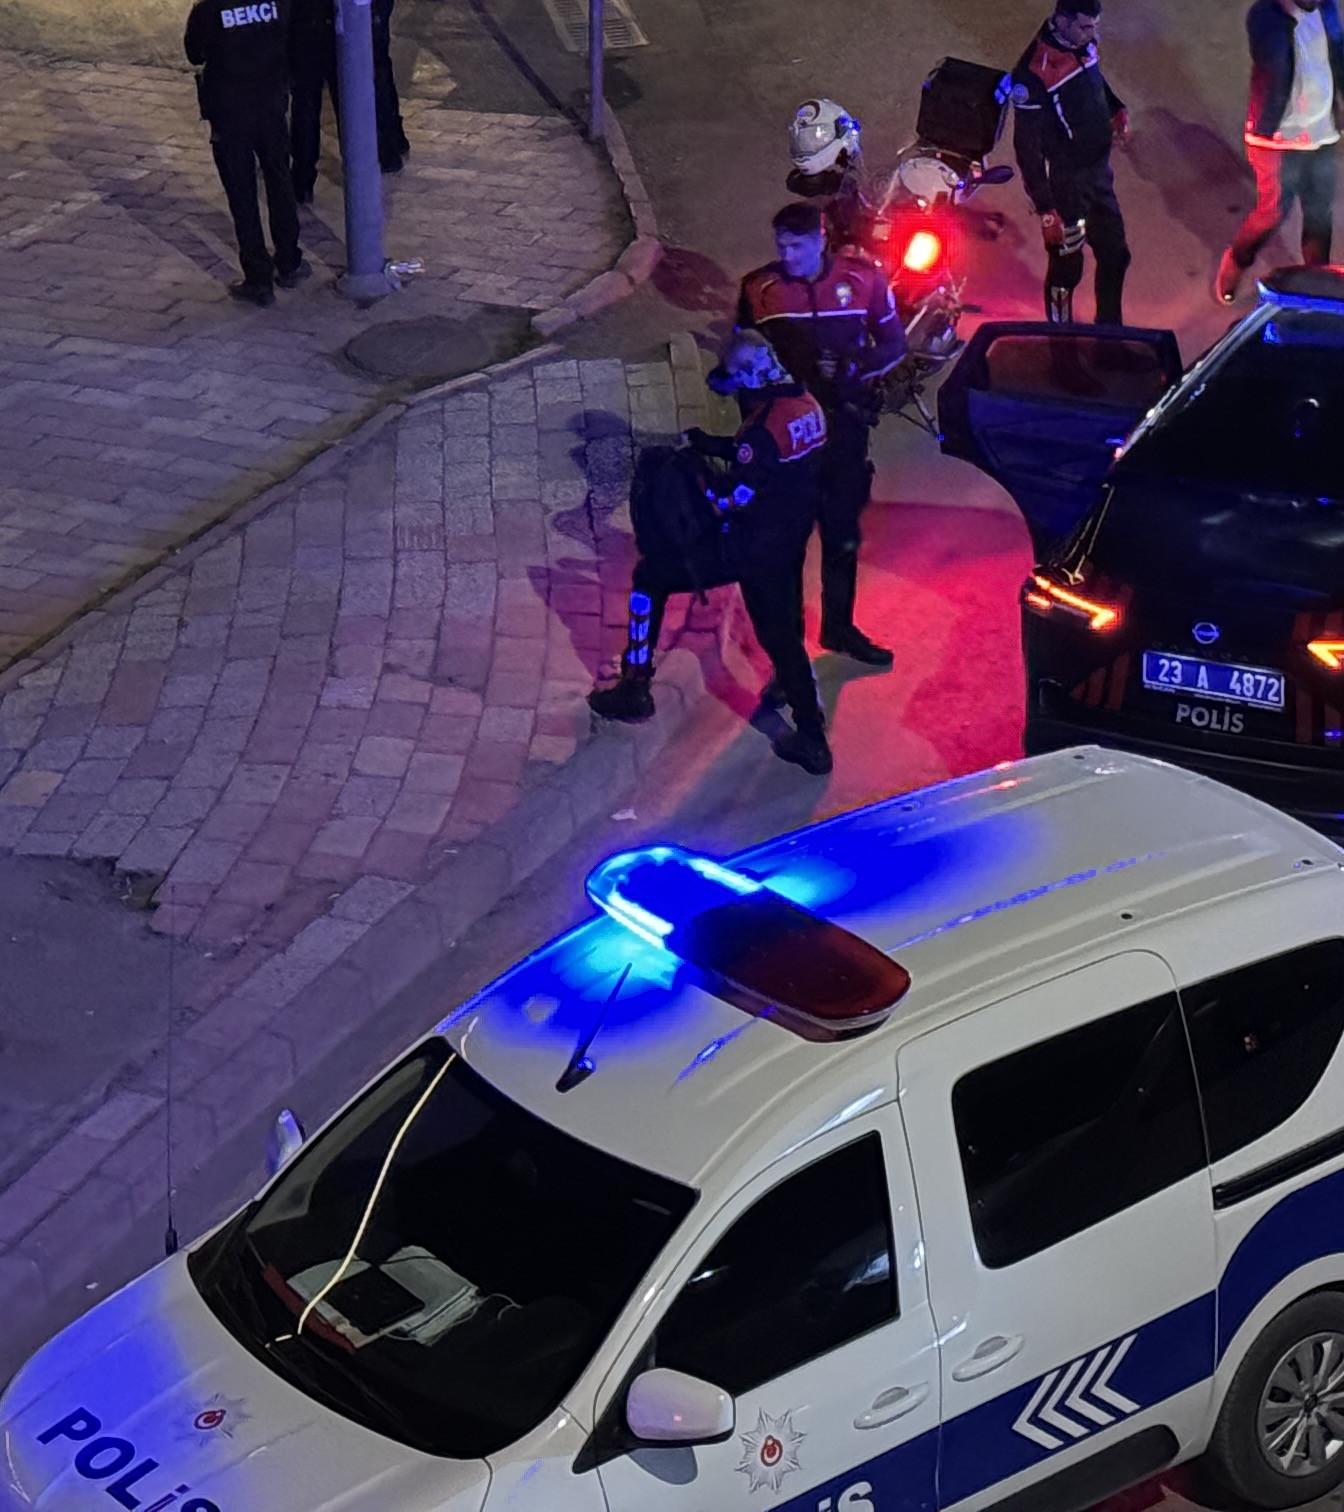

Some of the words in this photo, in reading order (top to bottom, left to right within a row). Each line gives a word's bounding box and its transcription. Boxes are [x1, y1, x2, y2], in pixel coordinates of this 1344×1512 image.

[221, 1, 278, 29] BEKÇİ
[1158, 658, 1183, 684] 23
[1197, 665, 1209, 690] A
[1229, 670, 1280, 702] 4872
[1175, 702, 1245, 734] POLİS
